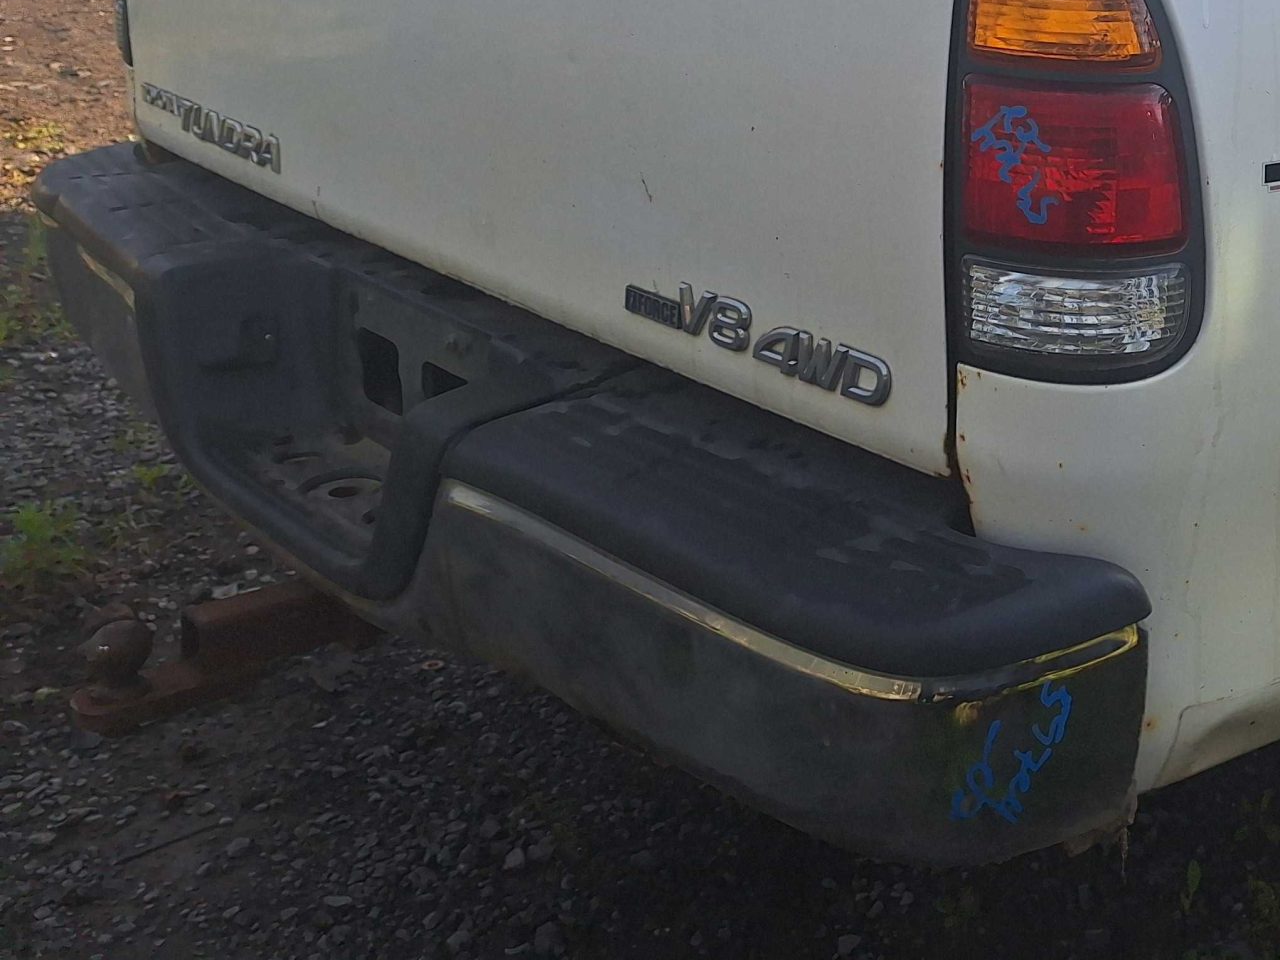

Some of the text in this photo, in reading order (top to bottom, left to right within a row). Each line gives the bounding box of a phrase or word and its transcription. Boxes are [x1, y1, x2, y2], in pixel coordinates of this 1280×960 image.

[178, 96, 282, 175] TUNDRA
[679, 281, 752, 352] V8
[753, 325, 892, 408] 4WD
